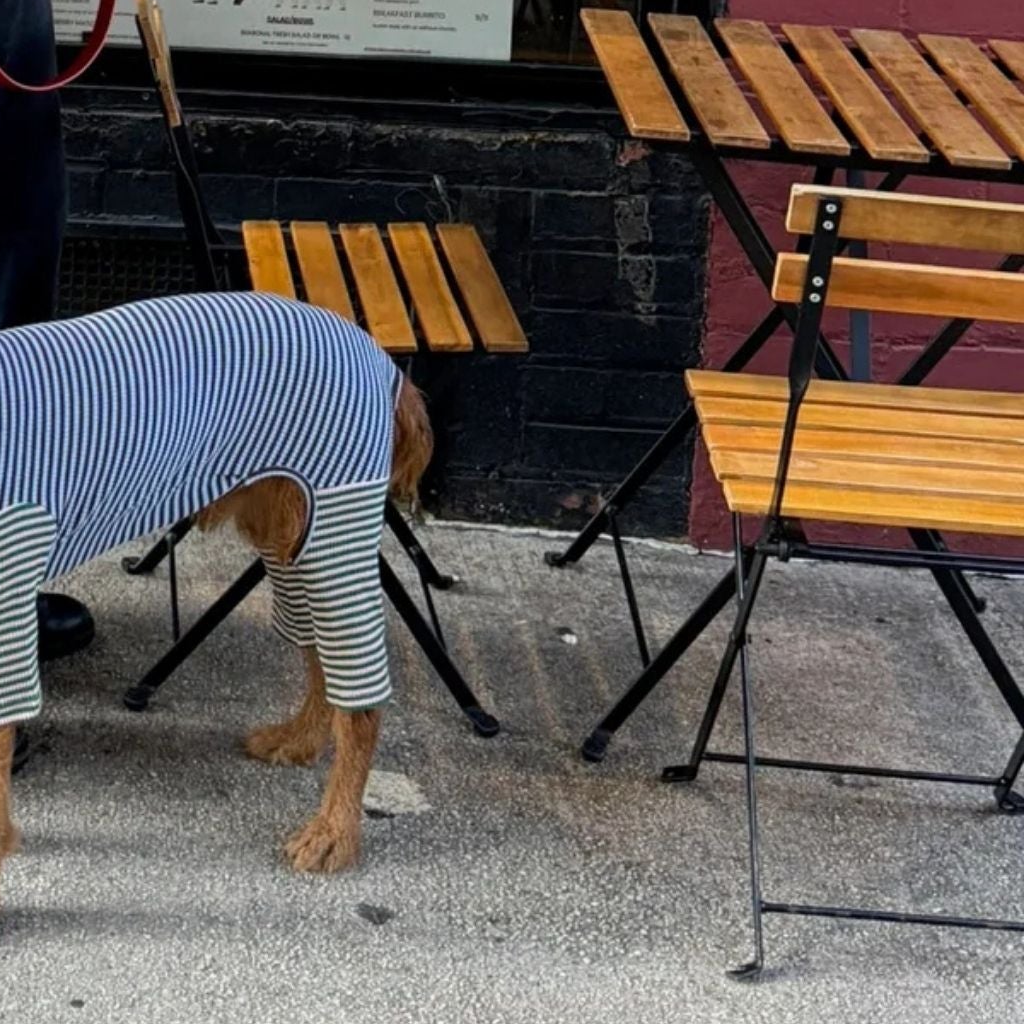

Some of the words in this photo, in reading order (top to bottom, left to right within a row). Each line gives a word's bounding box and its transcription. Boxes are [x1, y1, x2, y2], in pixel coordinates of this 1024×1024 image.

[373, 10, 412, 18] BREAKFAST
[414, 11, 446, 20] BURRITO
[266, 16, 314, 26] SALAD/BOWL
